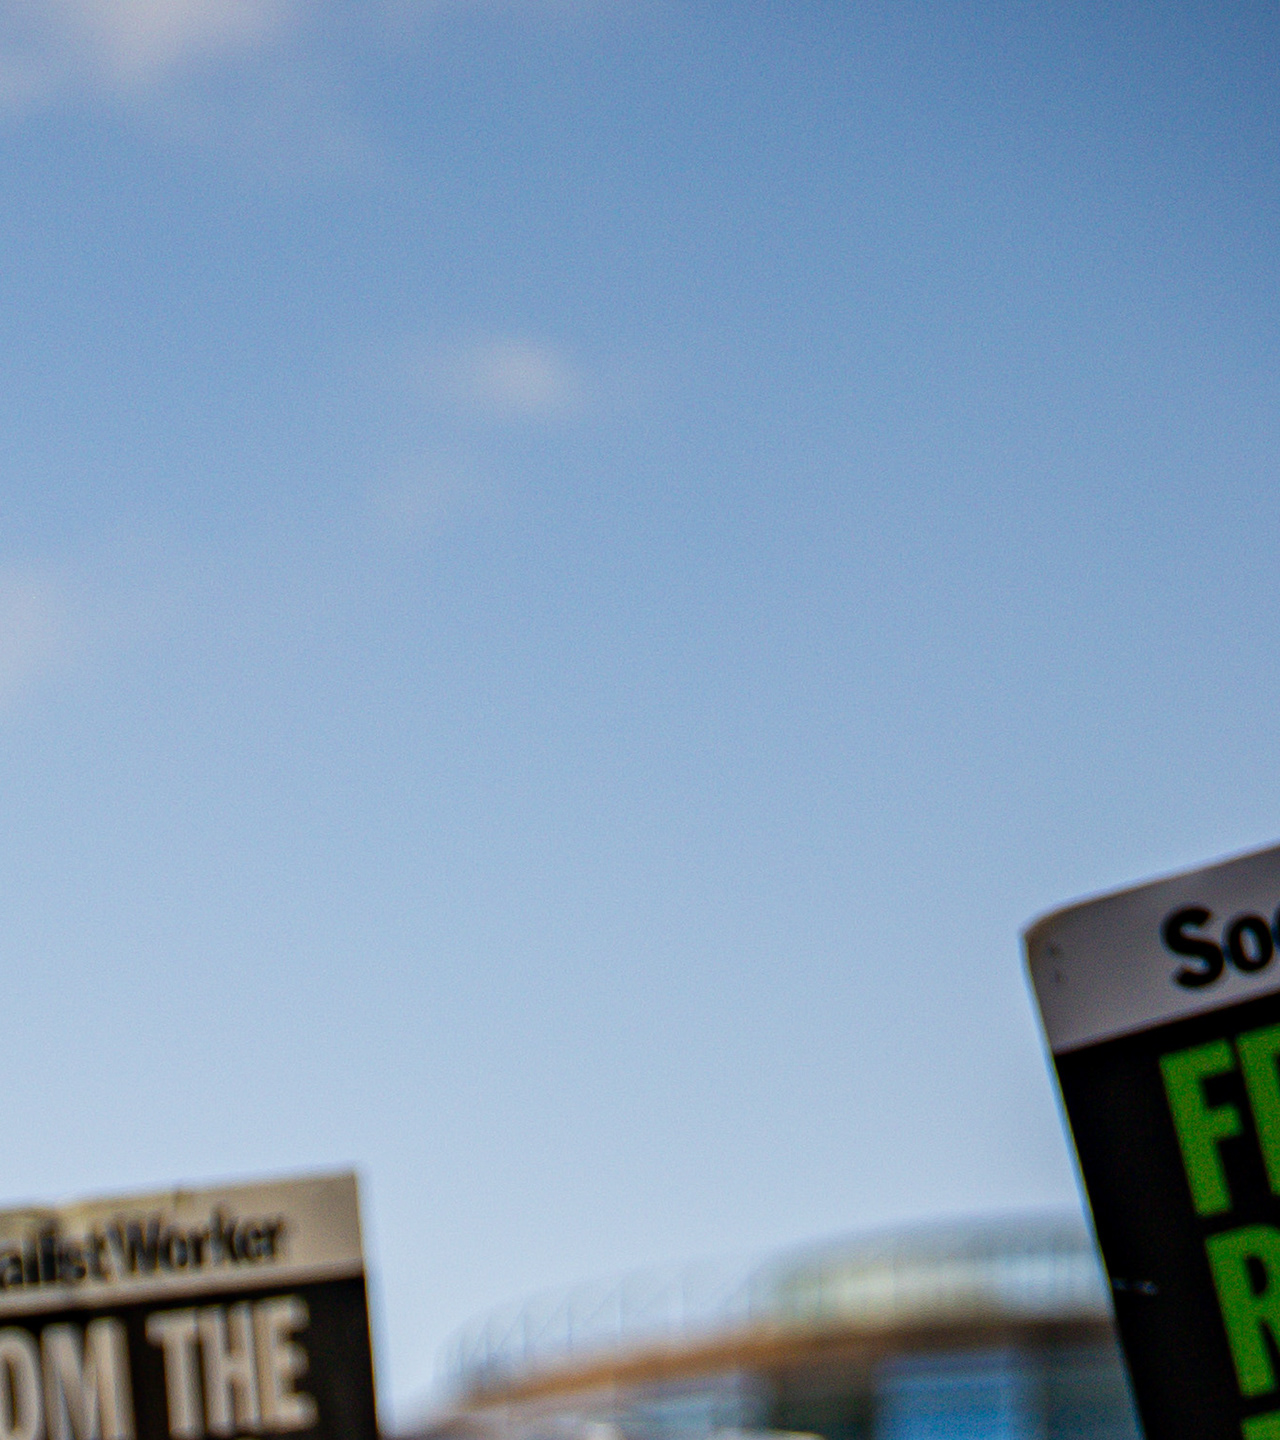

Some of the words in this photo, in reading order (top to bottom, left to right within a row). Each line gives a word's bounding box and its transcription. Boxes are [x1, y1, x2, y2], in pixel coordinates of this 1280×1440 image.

[1159, 902, 1280, 990] So
[106, 1204, 288, 1276] Worker
[146, 1293, 318, 1440] THE
